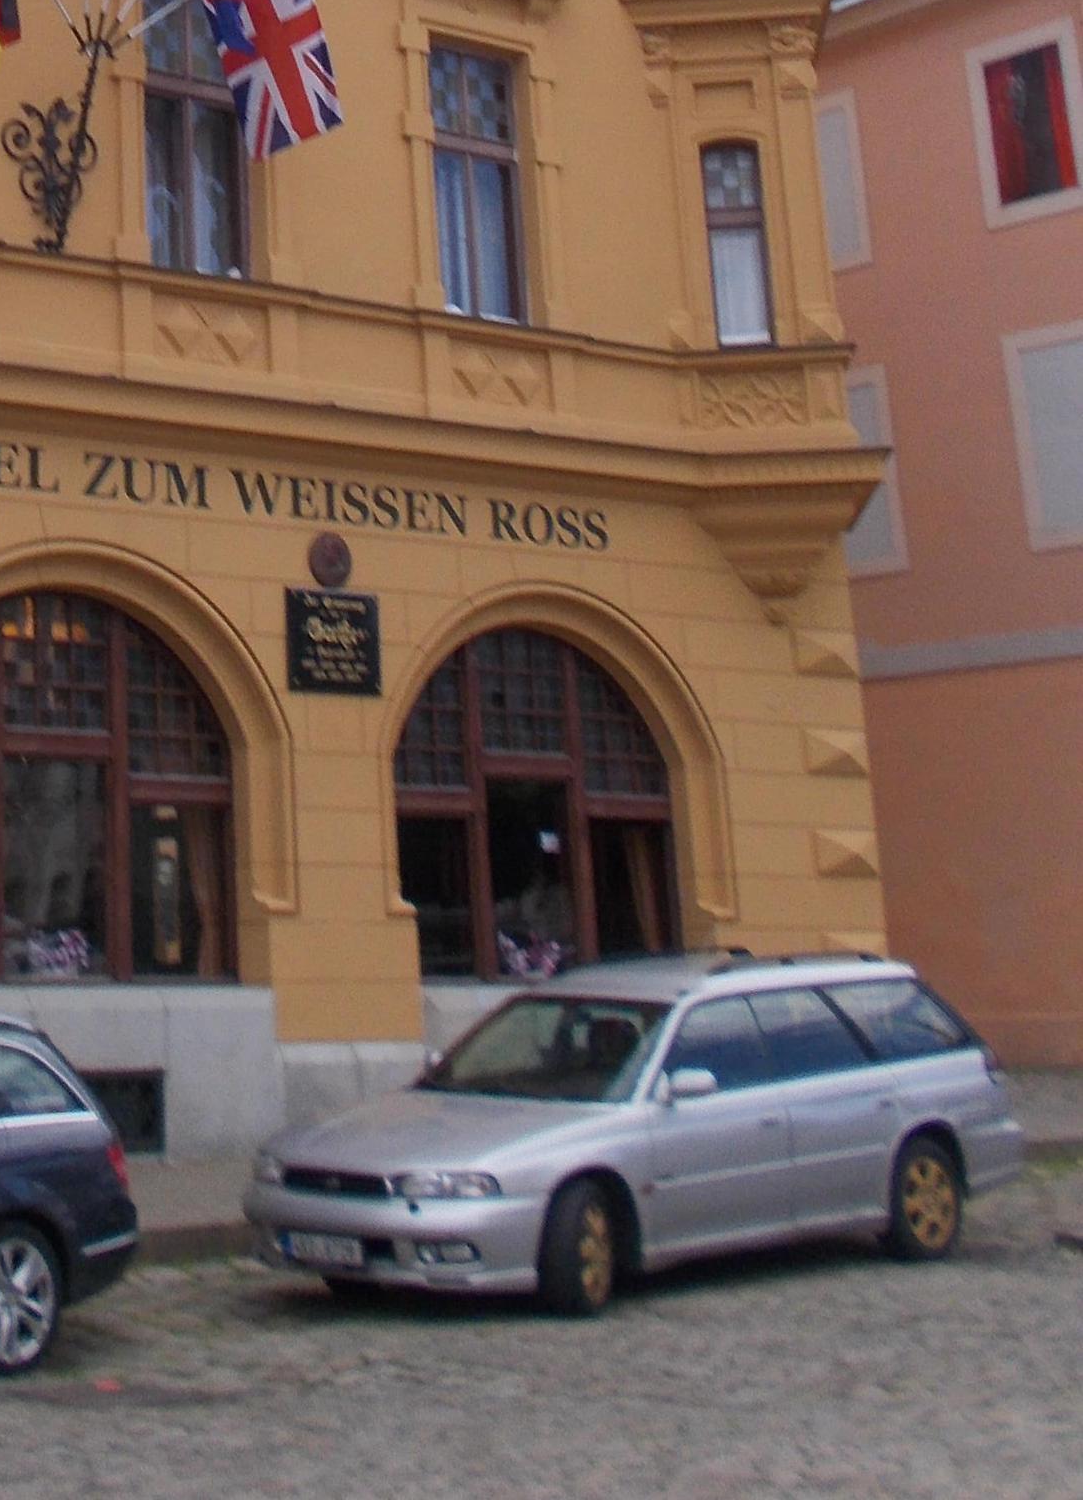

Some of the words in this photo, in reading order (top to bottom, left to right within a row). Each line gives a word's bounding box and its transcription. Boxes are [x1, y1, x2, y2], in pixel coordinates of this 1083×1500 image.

[83, 451, 211, 510] ZUM
[229, 469, 469, 537] WEISSEN
[489, 499, 610, 551] ROSS
